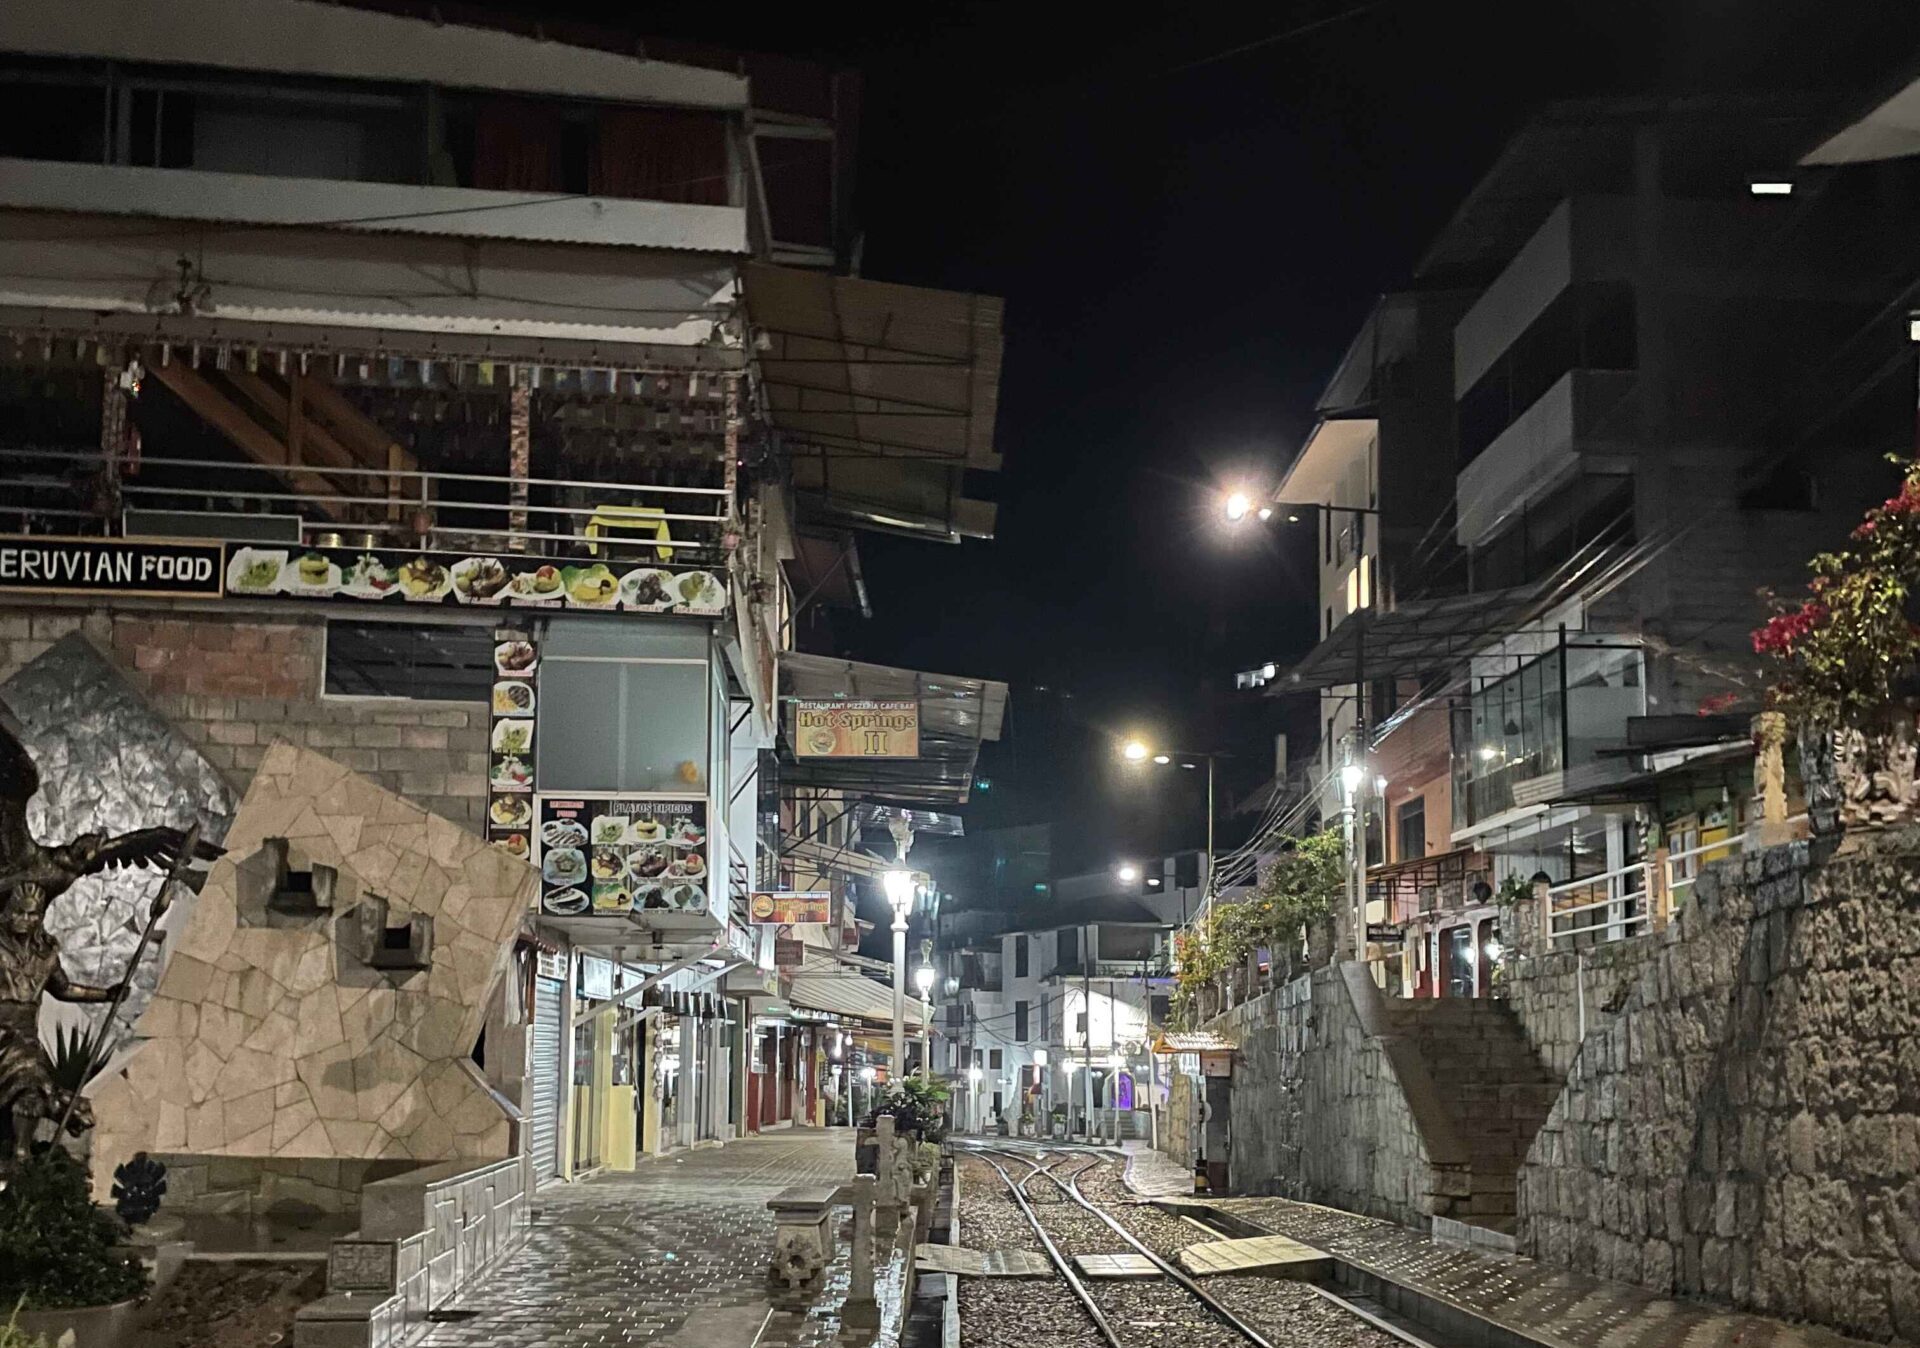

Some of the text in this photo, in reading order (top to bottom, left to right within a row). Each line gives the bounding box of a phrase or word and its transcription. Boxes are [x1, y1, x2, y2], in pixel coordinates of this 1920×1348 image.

[0, 548, 212, 582] ERUVIAN FOOD
[799, 702, 845, 710] RESTAURANT
[847, 702, 879, 710] PIZZERIA
[799, 711, 916, 731] Hot Springs
[864, 731, 888, 755] II
[613, 802, 693, 814] PLATOS TIPICOS
